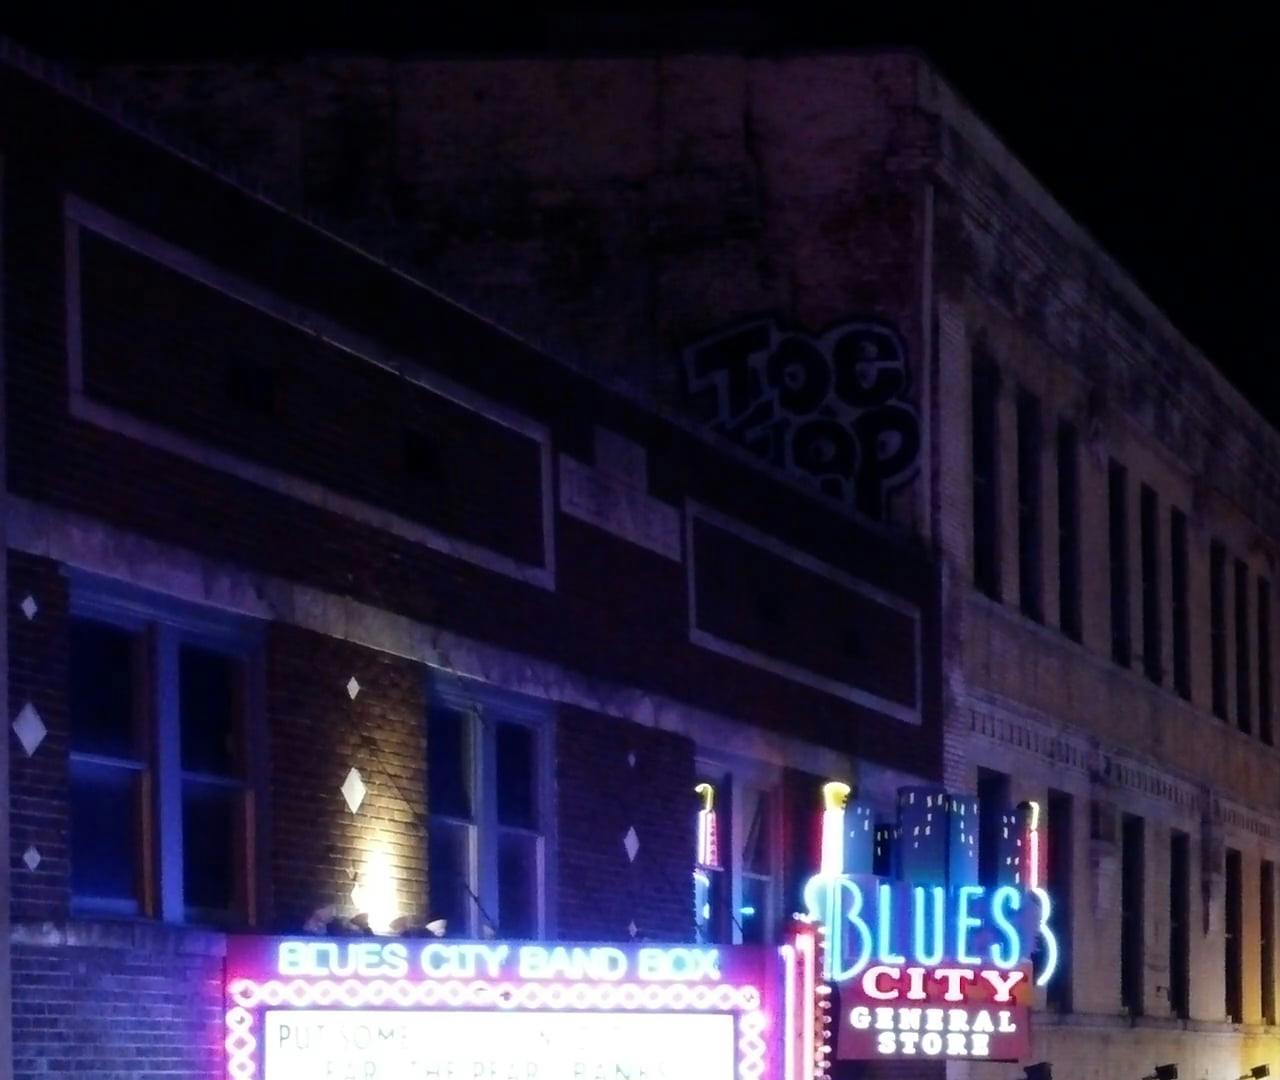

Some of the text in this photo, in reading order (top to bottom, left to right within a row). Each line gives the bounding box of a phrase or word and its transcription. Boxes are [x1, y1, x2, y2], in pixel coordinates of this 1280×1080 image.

[805, 873, 1022, 982] BLUES
[278, 941, 721, 981] BLUES CITY BAND BOX
[862, 966, 1025, 1002] CITY
[849, 1007, 1018, 1033] GENERAL
[877, 1032, 991, 1057] STORE
